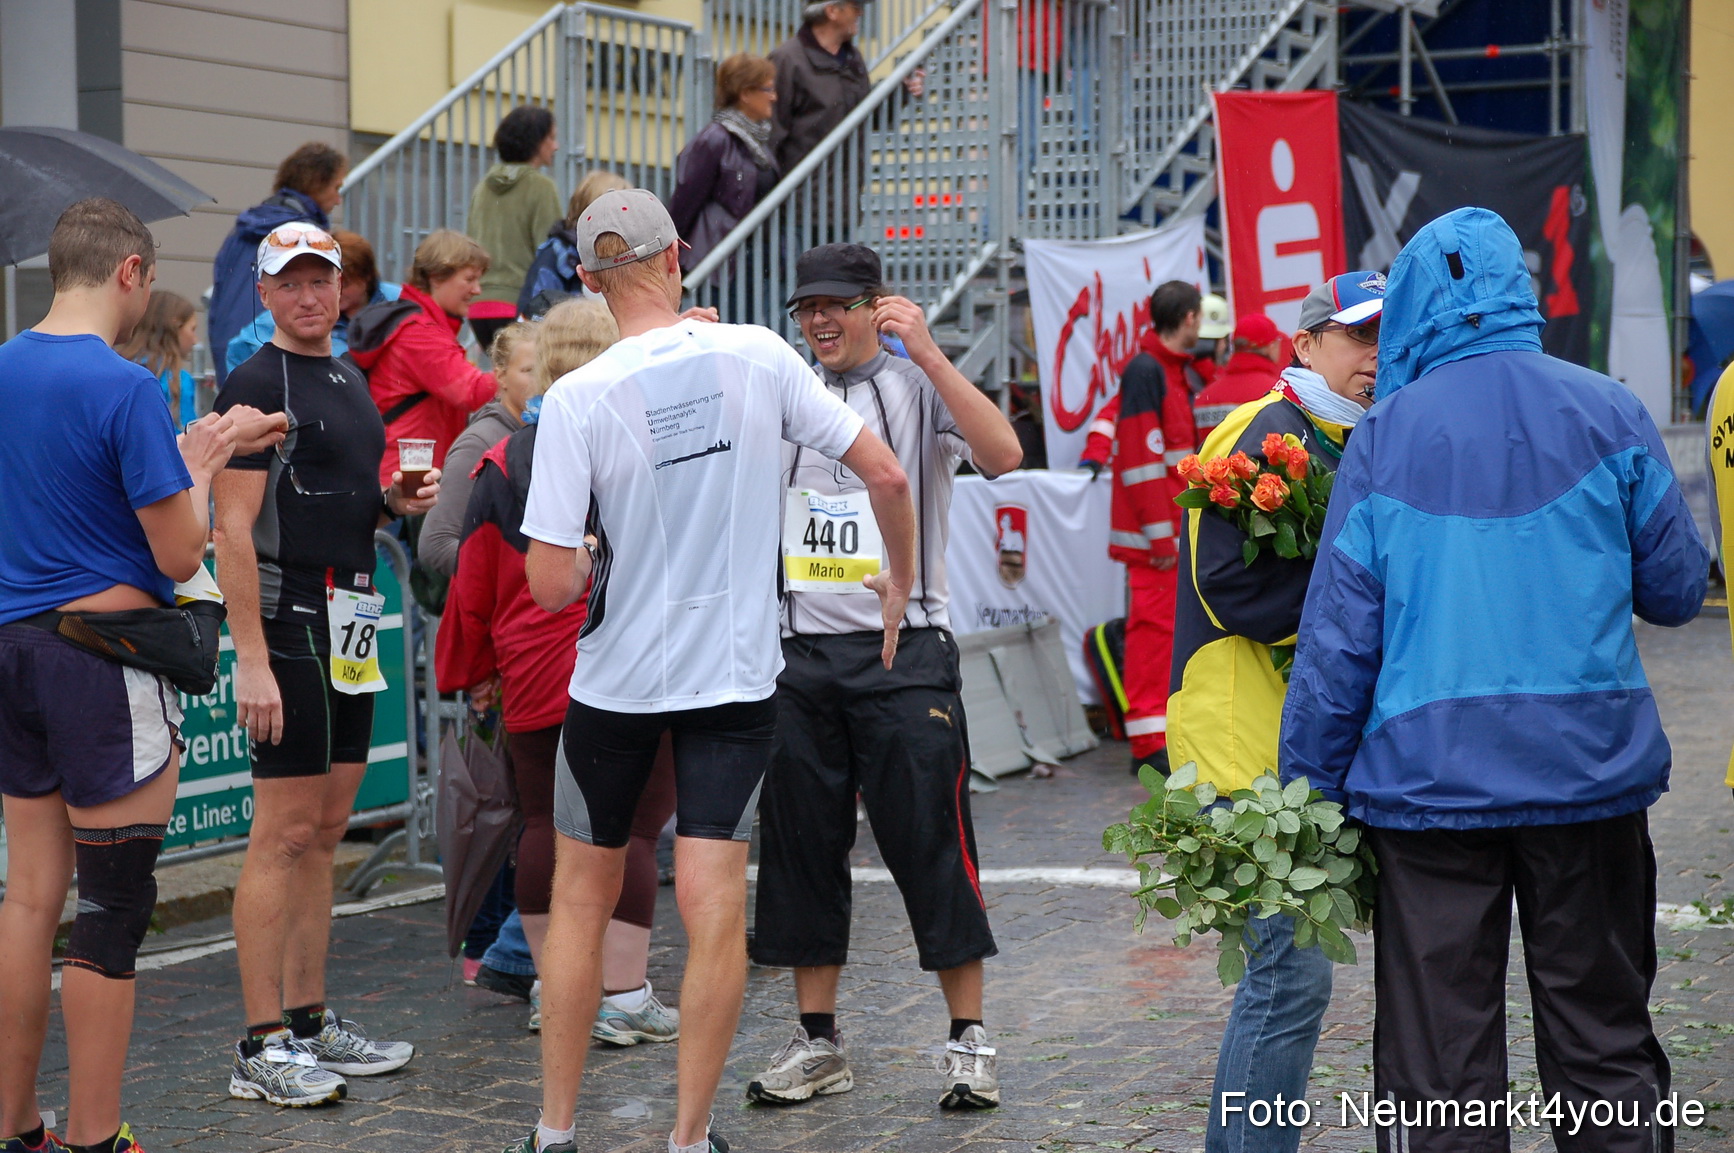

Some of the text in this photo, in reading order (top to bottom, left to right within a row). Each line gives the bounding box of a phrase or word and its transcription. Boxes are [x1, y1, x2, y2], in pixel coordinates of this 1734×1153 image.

[710, 391, 724, 401] und
[647, 408, 698, 427] Umweltanalytik
[650, 422, 680, 436] Nürnberg
[803, 517, 859, 555] 440
[809, 562, 845, 579] Mario
[341, 620, 375, 660] 18
[193, 803, 236, 831] Line:
